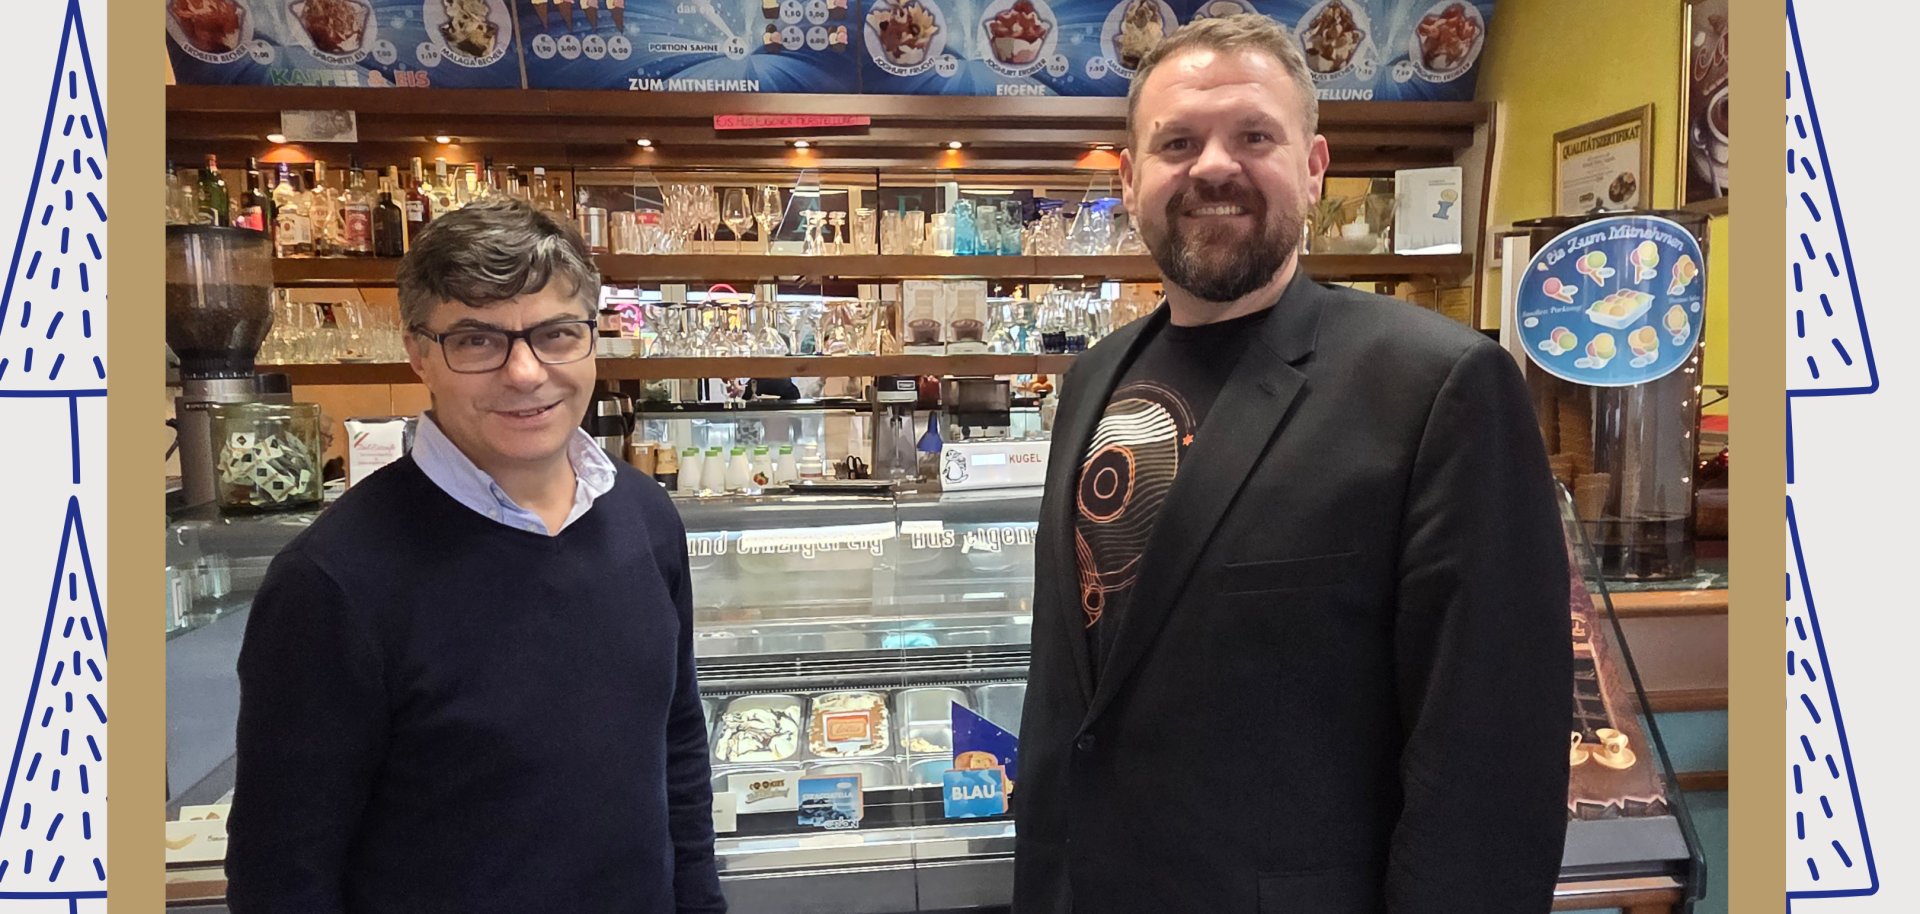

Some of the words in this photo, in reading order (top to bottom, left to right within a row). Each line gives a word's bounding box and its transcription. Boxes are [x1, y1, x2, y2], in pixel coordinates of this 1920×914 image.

[677, 2, 696, 13] das
[183, 43, 218, 62] ERDBEER
[220, 45, 246, 61] BECHER
[650, 43, 687, 51] PORTION
[313, 49, 353, 63] SPAGHETTI
[353, 50, 366, 60] EIS
[441, 48, 476, 66] MALAGA
[478, 48, 503, 65] BECHER
[875, 57, 907, 75] JOGHURT
[909, 57, 935, 74] FRUCHT
[986, 59, 1016, 77] JOGHURT
[1018, 60, 1047, 77] ERDBEER
[271, 68, 359, 86] KAFFEE
[367, 69, 387, 87] &
[394, 70, 430, 87] EIS
[629, 78, 664, 91] ZUM
[669, 79, 760, 93] MITNEHMEN
[996, 84, 1045, 96] EIGENE
[1546, 248, 1566, 265] Eis
[1567, 232, 1606, 253] Zum
[1608, 225, 1684, 251] Mitnehmen
[1009, 453, 1042, 464] KUGEL
[952, 784, 996, 801] BLAU
